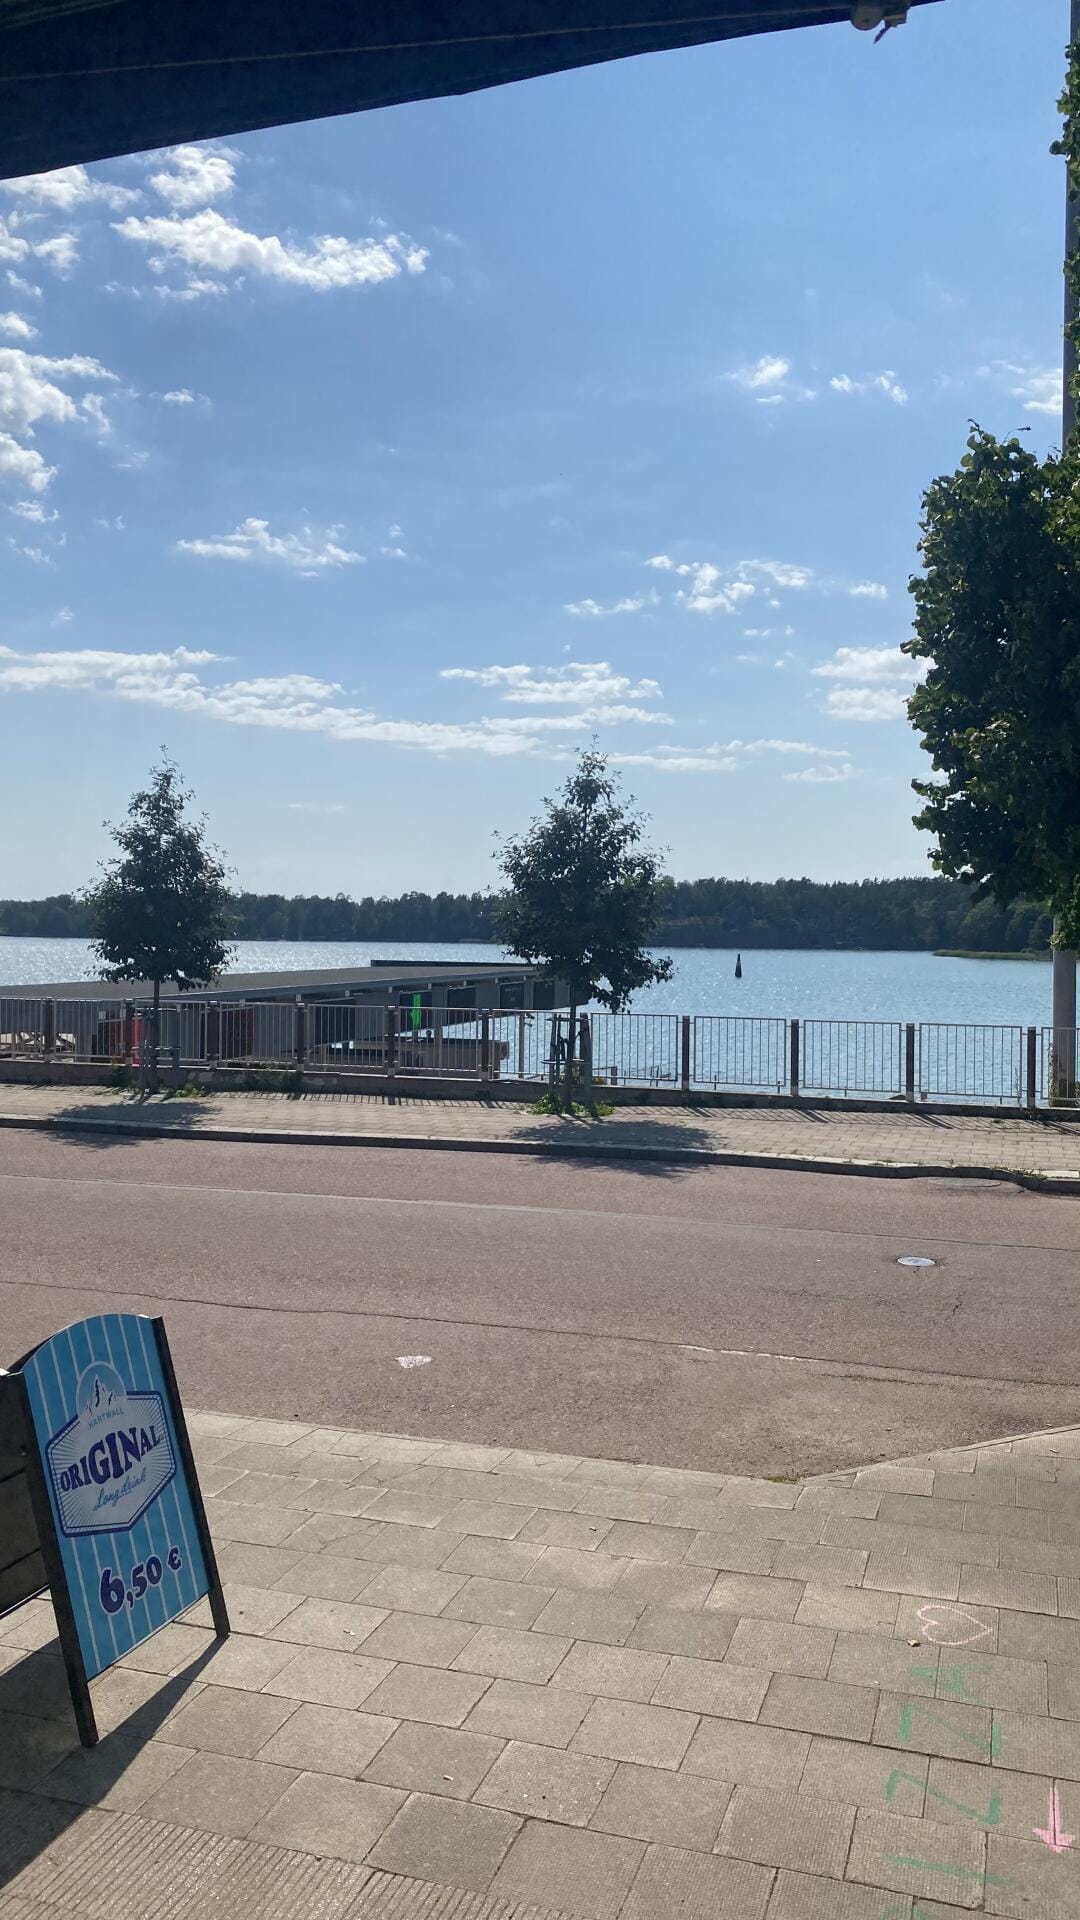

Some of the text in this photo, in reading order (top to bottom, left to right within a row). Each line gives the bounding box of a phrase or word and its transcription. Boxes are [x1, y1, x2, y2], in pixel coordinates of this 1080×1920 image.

[87, 1407, 125, 1432] HARTWALL
[60, 1425, 161, 1493] ORIGINAL
[100, 1545, 182, 1615] 6,50 €
